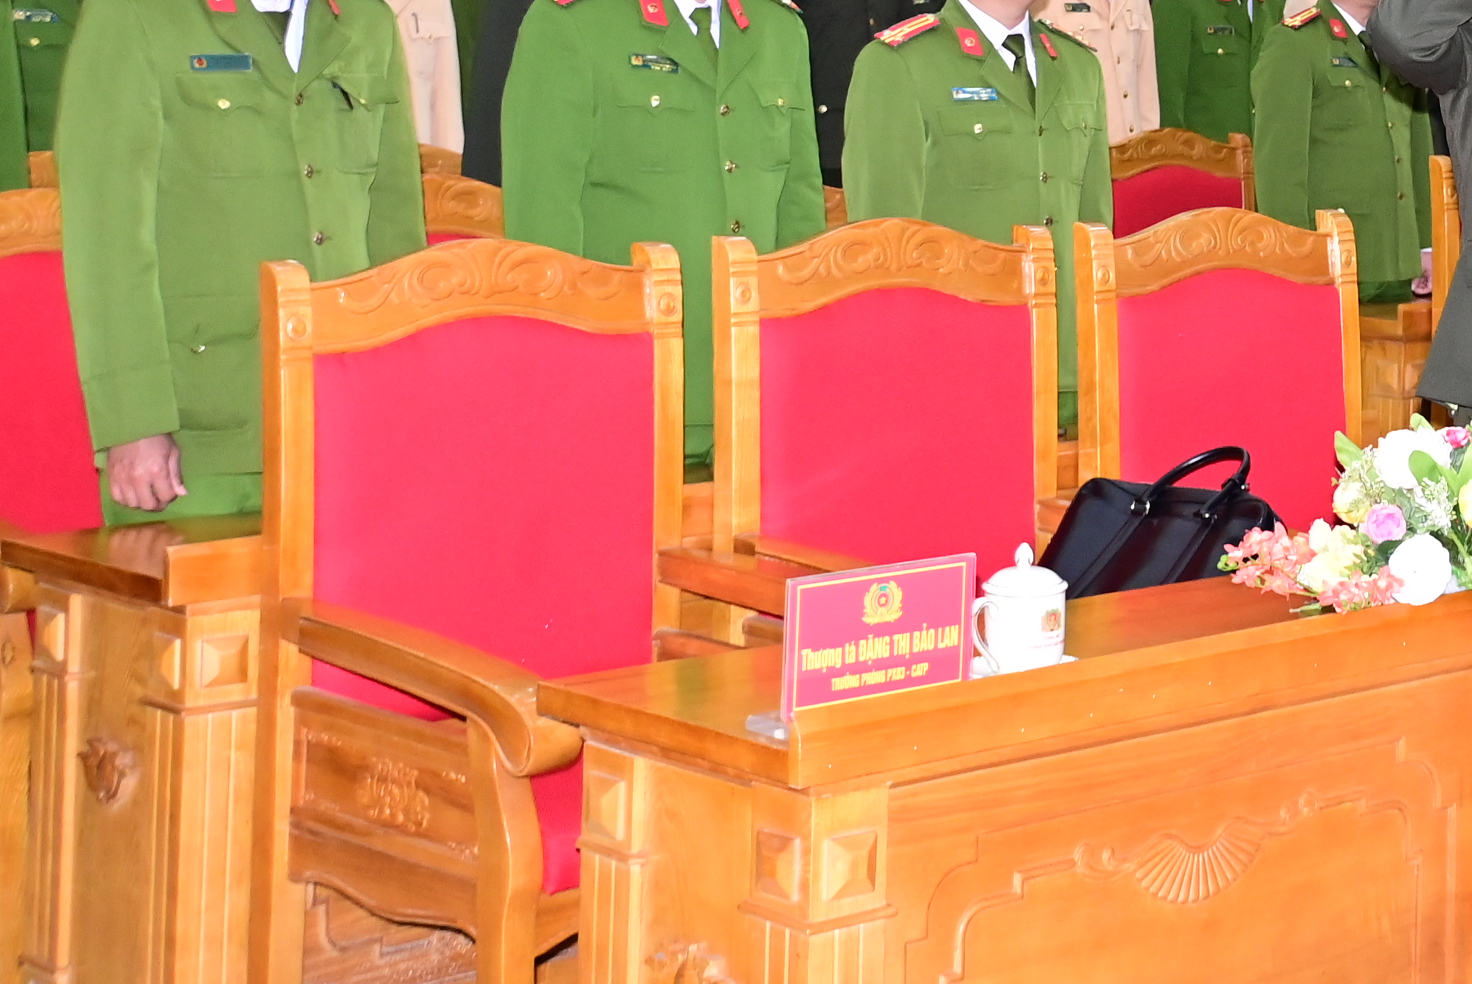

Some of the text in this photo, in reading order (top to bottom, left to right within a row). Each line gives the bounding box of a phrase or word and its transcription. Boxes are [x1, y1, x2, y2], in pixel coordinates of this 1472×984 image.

[801, 622, 959, 673] Thượng tá ĐẶNG THỊ BẢO LAN
[911, 662, 929, 678] CATP
